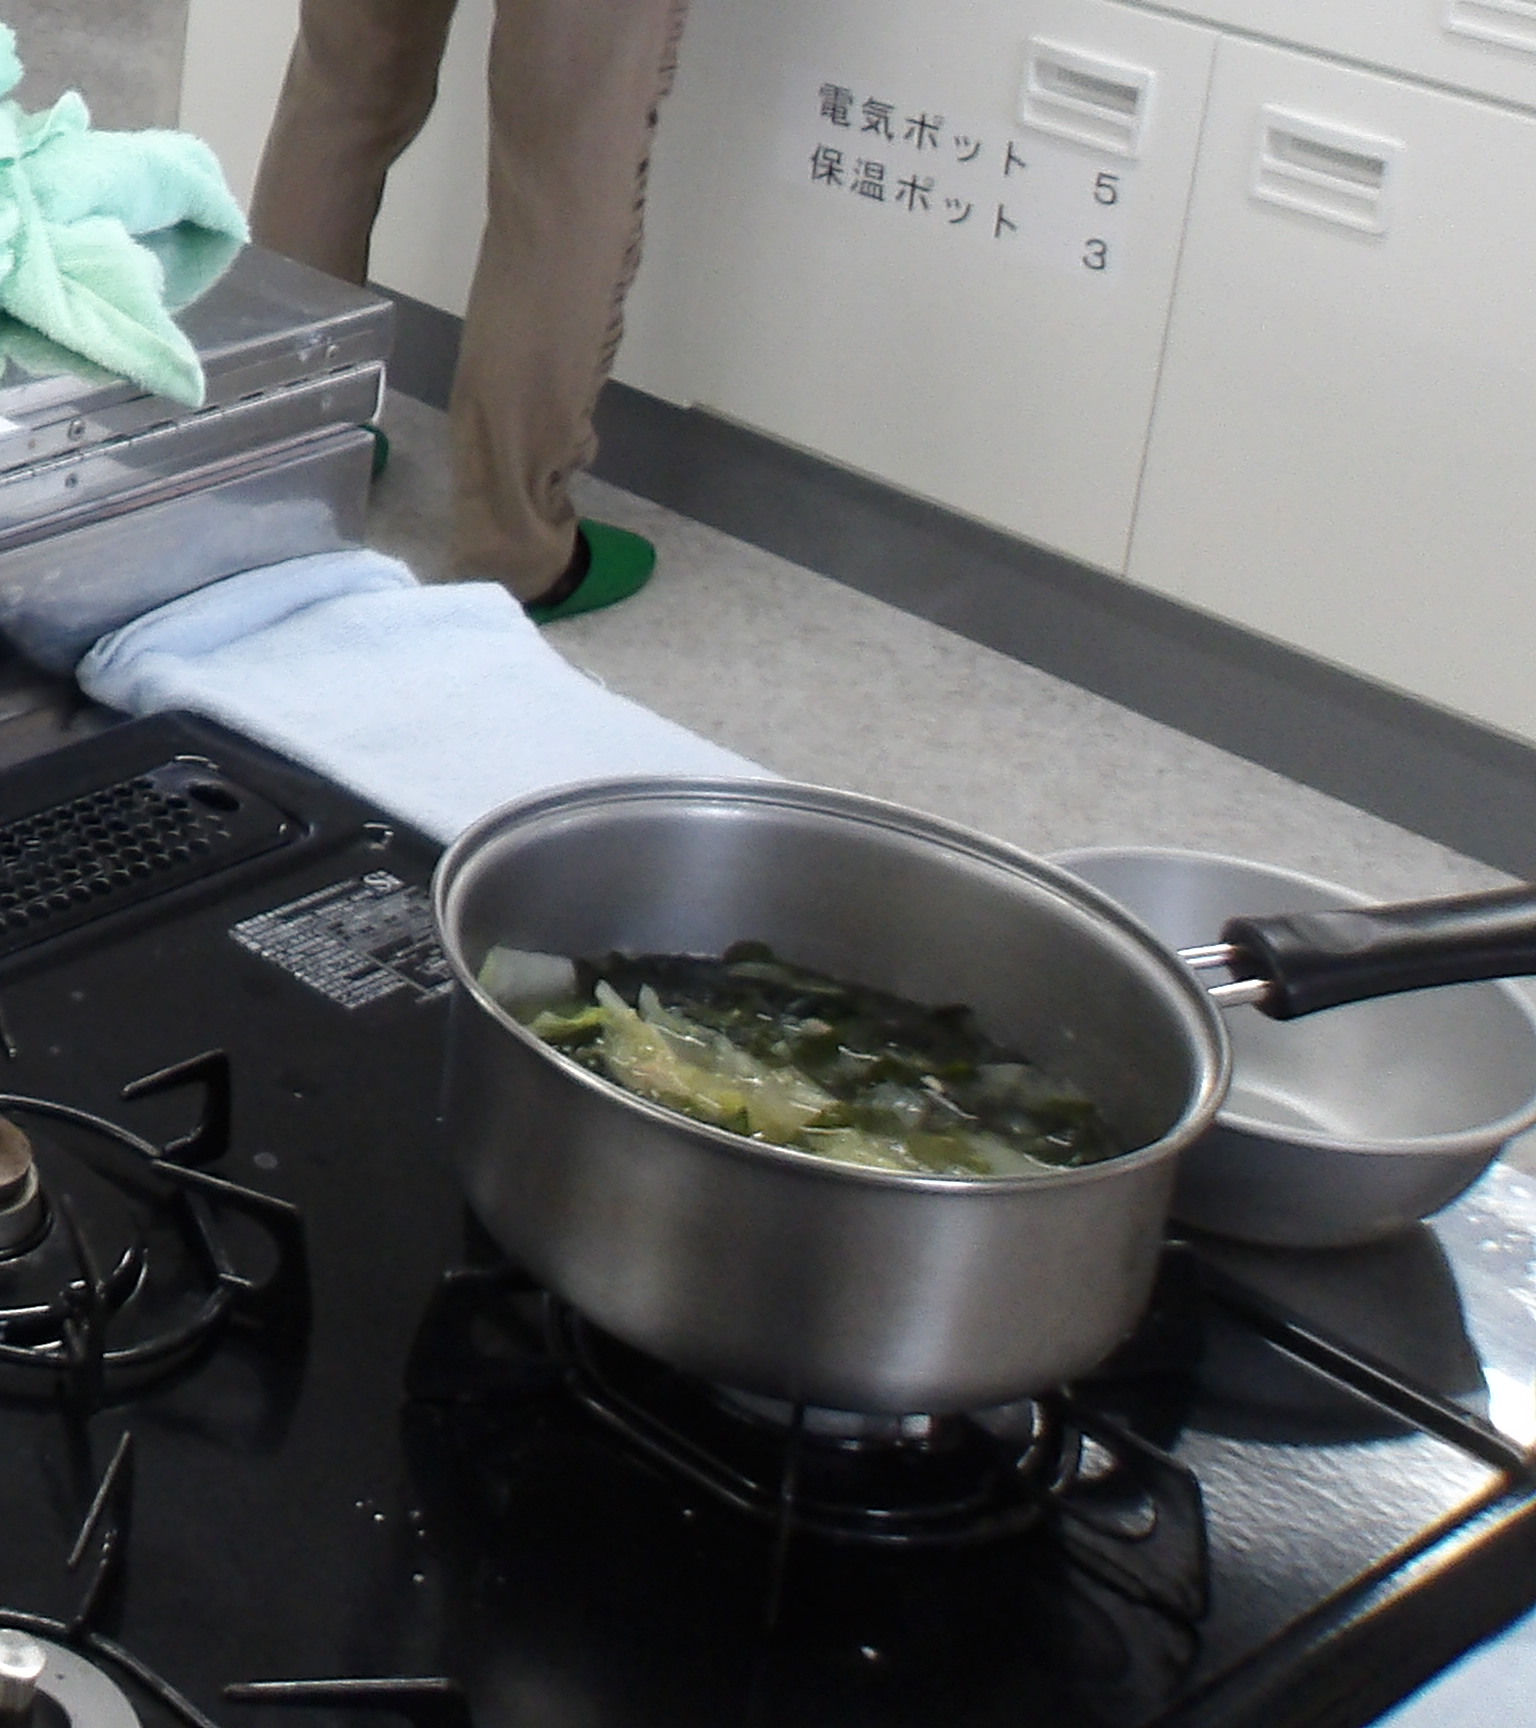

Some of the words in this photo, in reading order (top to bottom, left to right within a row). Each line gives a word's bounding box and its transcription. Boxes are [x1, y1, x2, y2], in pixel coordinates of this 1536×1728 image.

[810, 142, 1017, 239] 保温ポット
[1081, 238, 1108, 271] 3
[818, 82, 1027, 176] 電気ポット
[1093, 172, 1121, 206] 5
